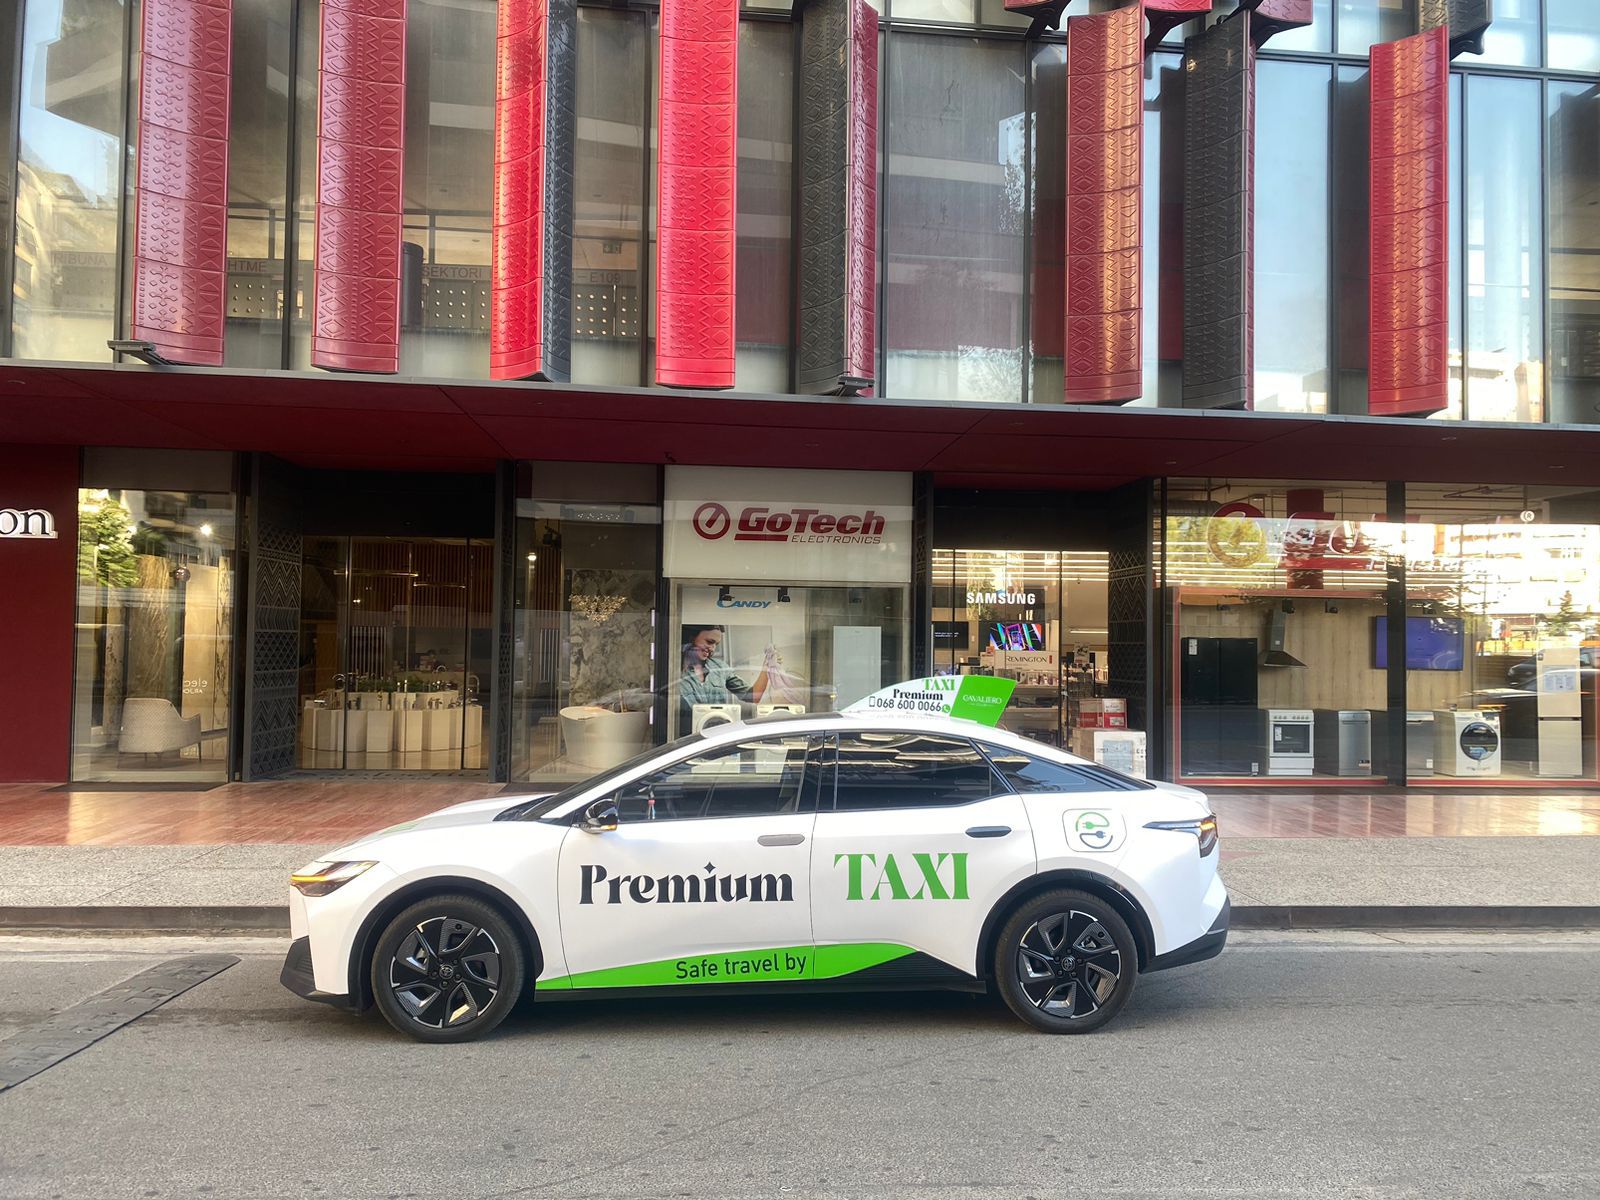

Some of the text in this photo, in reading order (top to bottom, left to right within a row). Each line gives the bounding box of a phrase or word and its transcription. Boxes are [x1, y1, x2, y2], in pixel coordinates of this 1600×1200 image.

[422, 265, 482, 279] SEKTORI
[737, 507, 886, 535] GoTech
[791, 534, 882, 545] ELECTRONICS
[966, 592, 1036, 605] SAMSUNG
[1005, 655, 1048, 664] REMINGTON
[922, 678, 956, 691] TAXI
[893, 688, 944, 701] Premium
[876, 698, 942, 712] 068 600 0066
[834, 852, 970, 900] TAXI
[579, 862, 793, 905] Premium
[675, 953, 807, 979] Safe travel by
